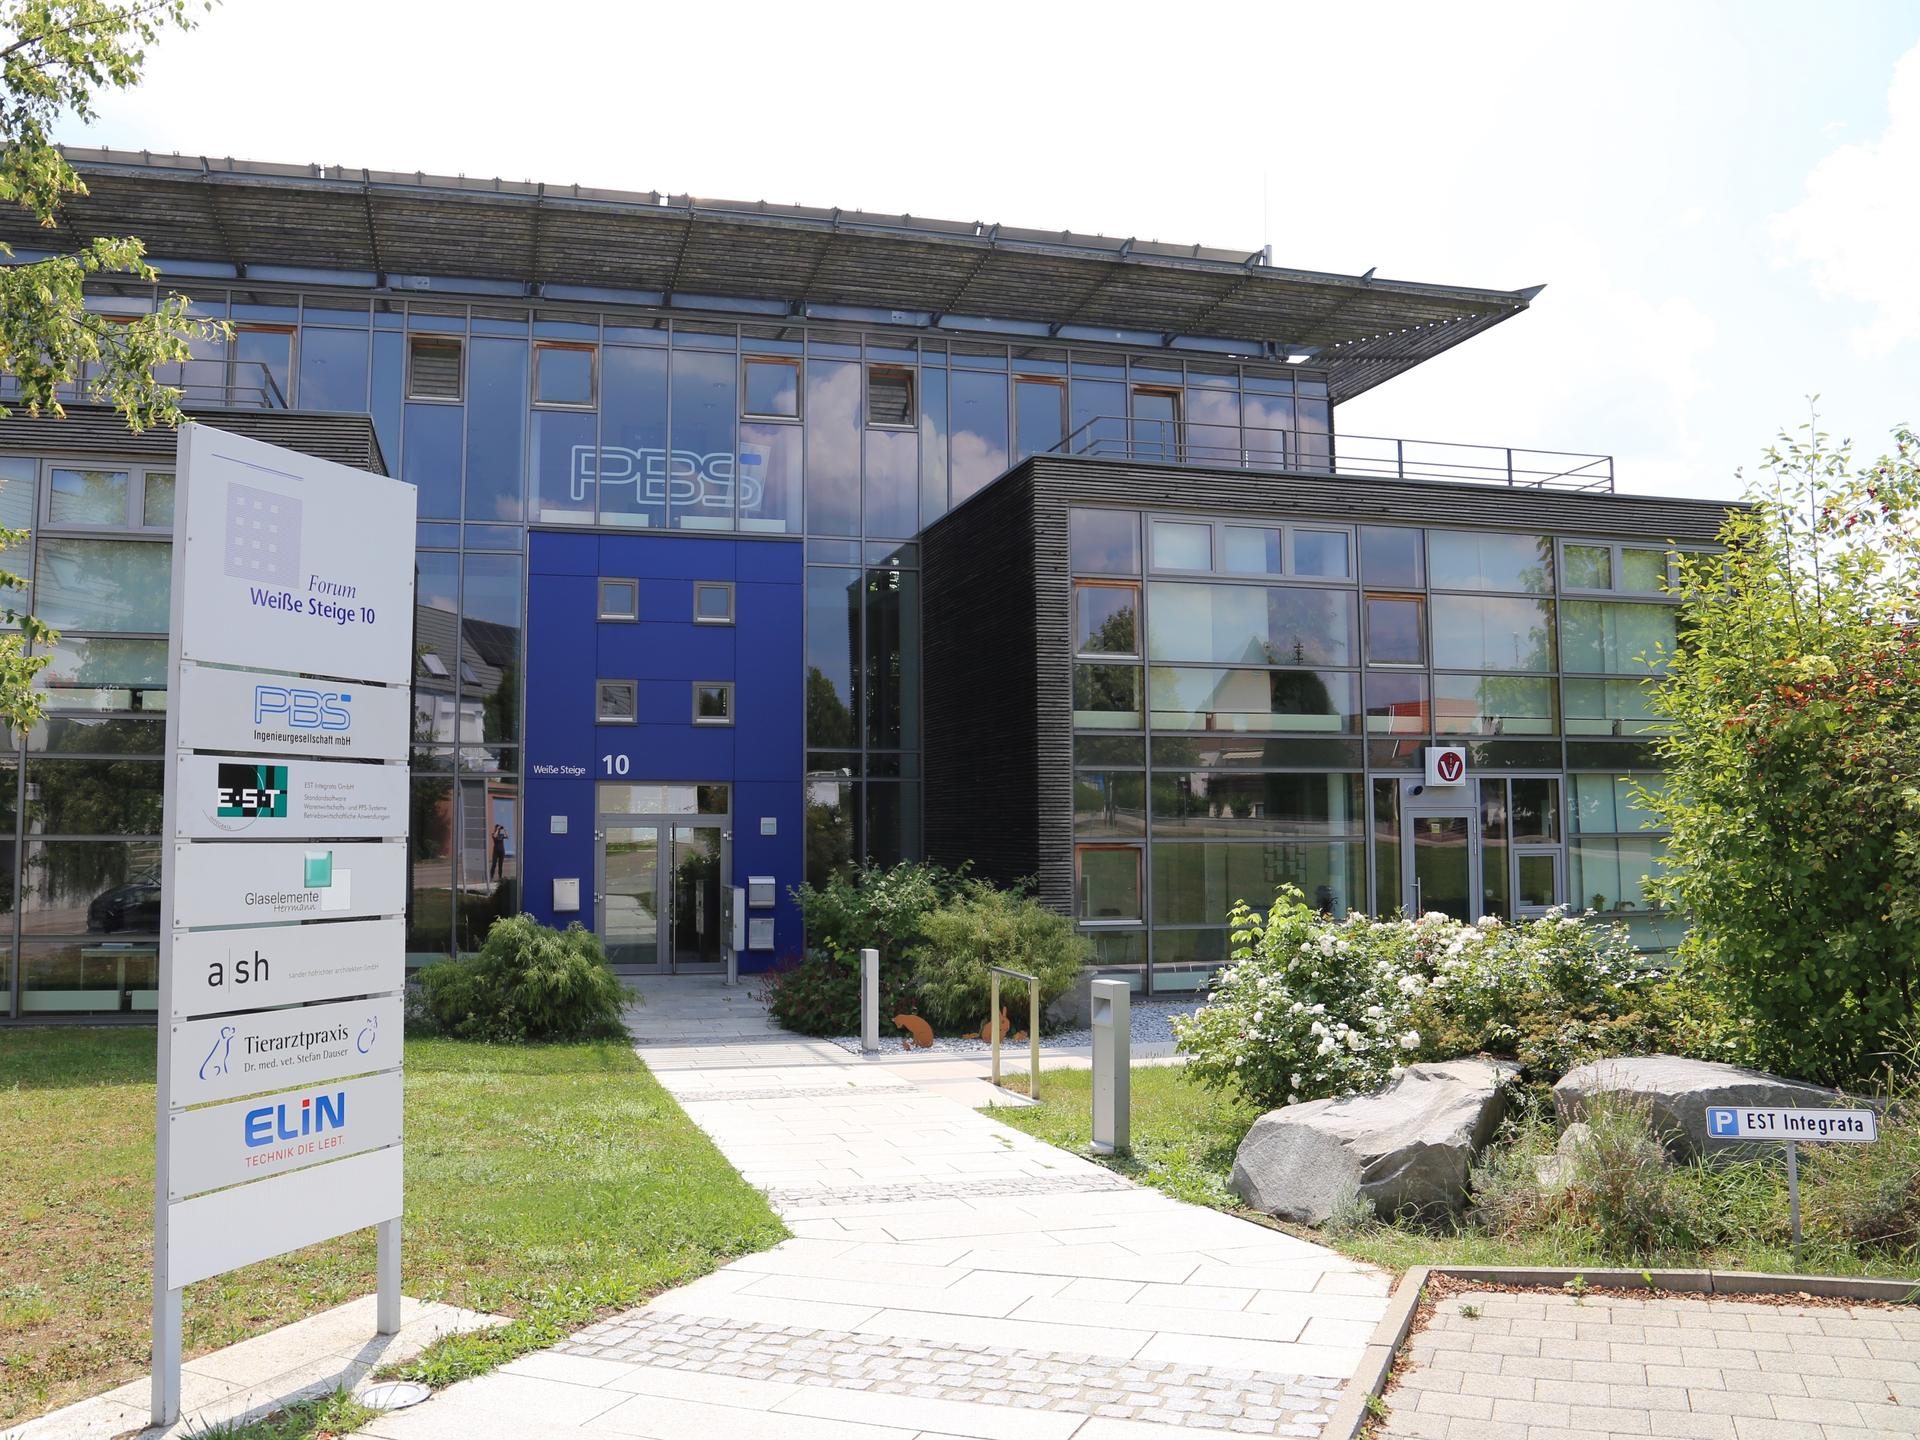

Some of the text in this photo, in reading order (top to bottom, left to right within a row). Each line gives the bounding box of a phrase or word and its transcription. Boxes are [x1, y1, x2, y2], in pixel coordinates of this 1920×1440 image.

[570, 444, 762, 509] PBS
[308, 574, 357, 599] Forum
[250, 587, 376, 625] Weiße Steige 10
[254, 685, 352, 731] PBS
[254, 730, 351, 746] Ingenieurgesellschaft mbH
[533, 754, 630, 776] Weiße Steige 10
[245, 890, 319, 906] Glaselemente
[273, 903, 317, 913] Herrmann
[244, 1023, 349, 1054] Tierarztpraxis
[244, 1048, 349, 1073] Dr. med. vet. Stefan Dauser
[1715, 1111, 1864, 1136] P EST Integrata
[245, 1135, 345, 1168] TECHNIK DIE LEBT.
